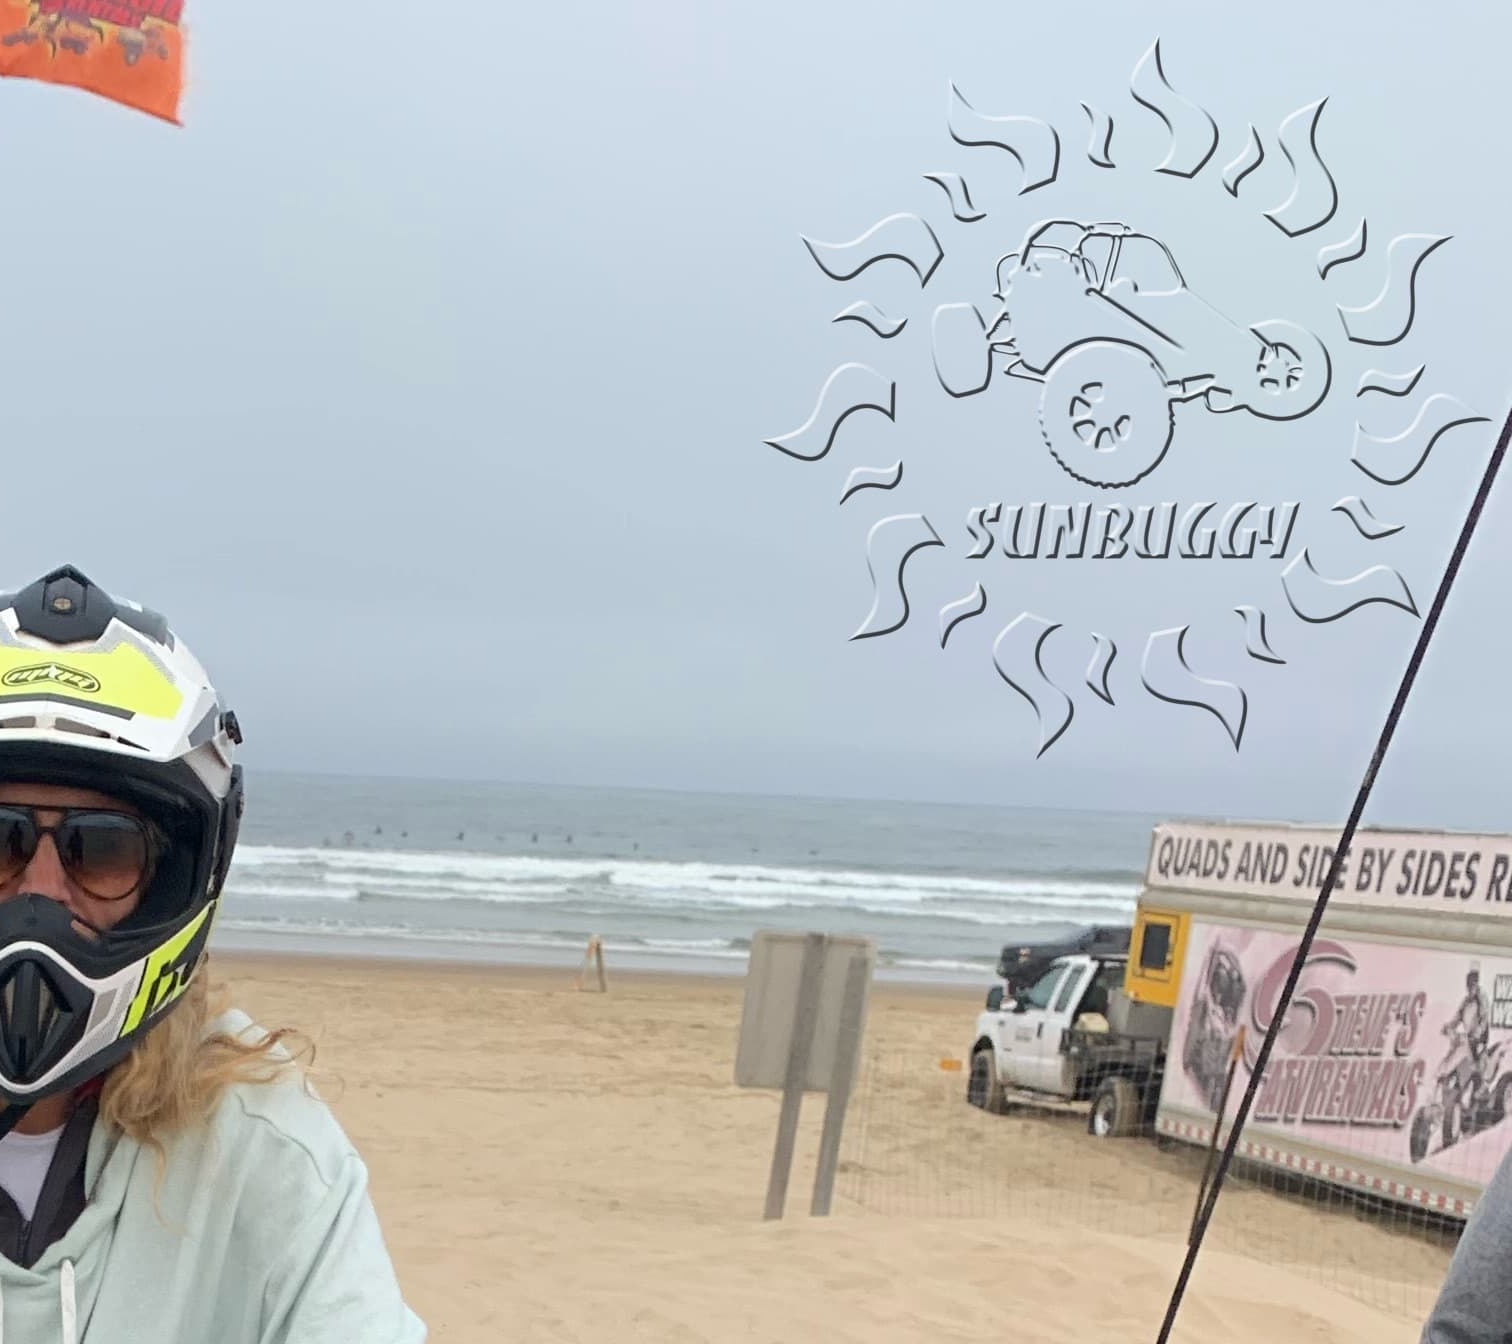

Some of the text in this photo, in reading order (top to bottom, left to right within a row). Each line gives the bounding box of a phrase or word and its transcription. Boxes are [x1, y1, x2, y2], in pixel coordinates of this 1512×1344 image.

[1157, 835, 1233, 881] QUADS
[1234, 841, 1289, 885] AND
[1292, 844, 1352, 890] SIDE
[1355, 848, 1395, 893] BY
[1396, 849, 1481, 900] SIDES
[1246, 940, 1426, 1074] STEVE'S
[1254, 1058, 1426, 1128] ATV RENTALS
